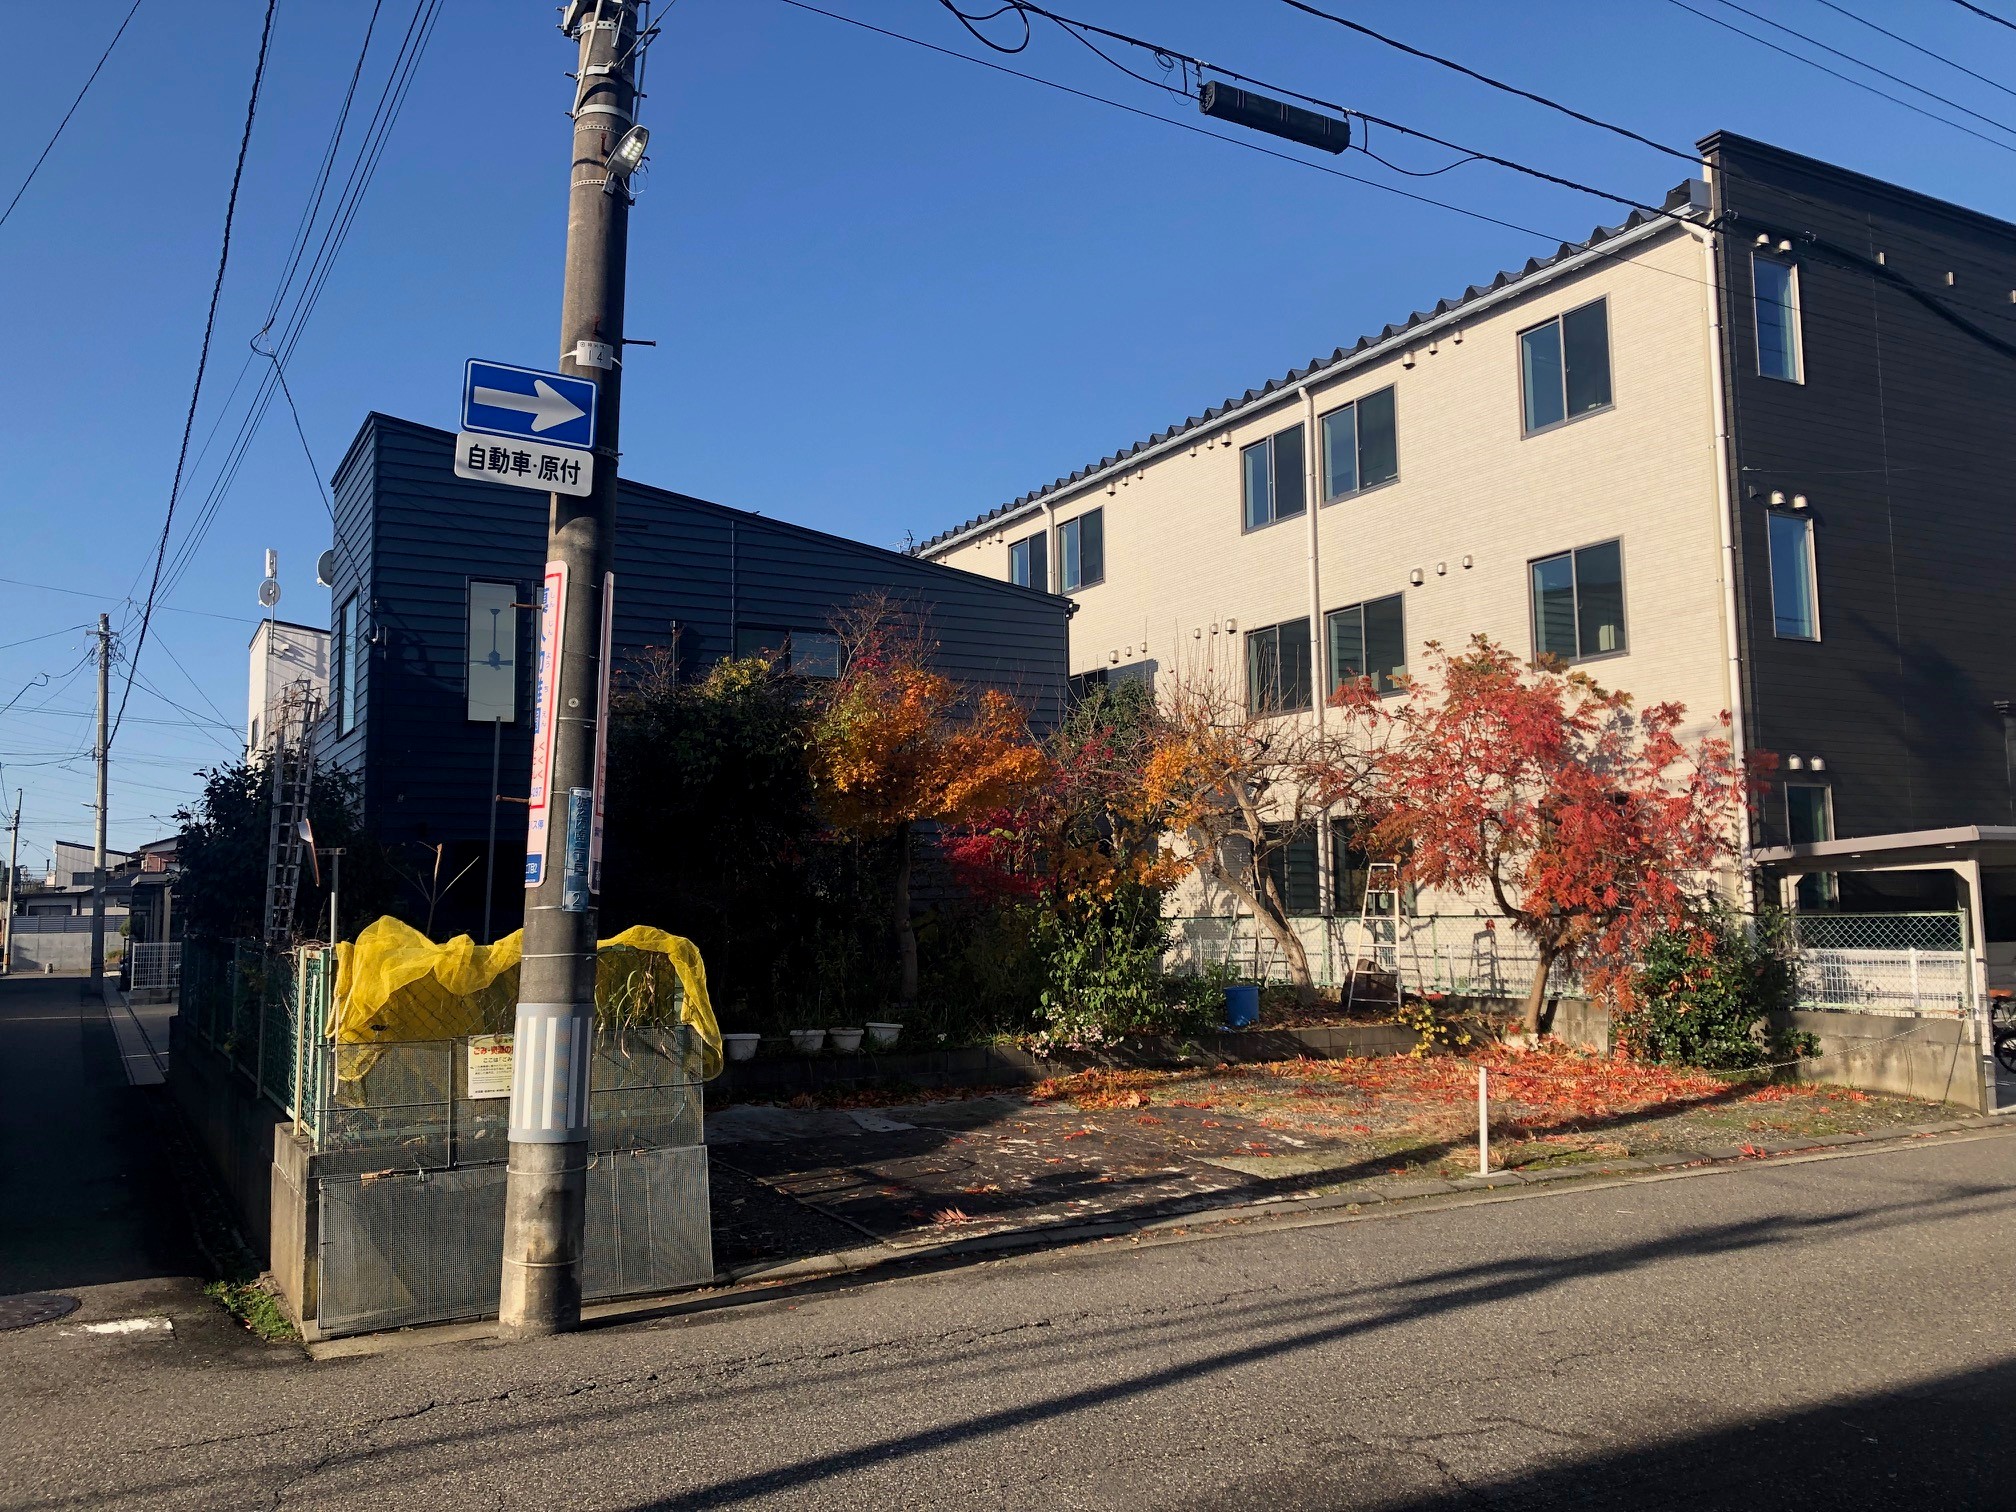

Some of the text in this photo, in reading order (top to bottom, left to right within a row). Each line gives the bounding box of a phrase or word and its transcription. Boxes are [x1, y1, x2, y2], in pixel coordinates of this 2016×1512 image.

[572, 892, 581, 907] 2
[473, 1045, 513, 1055] ごみ・資源の
